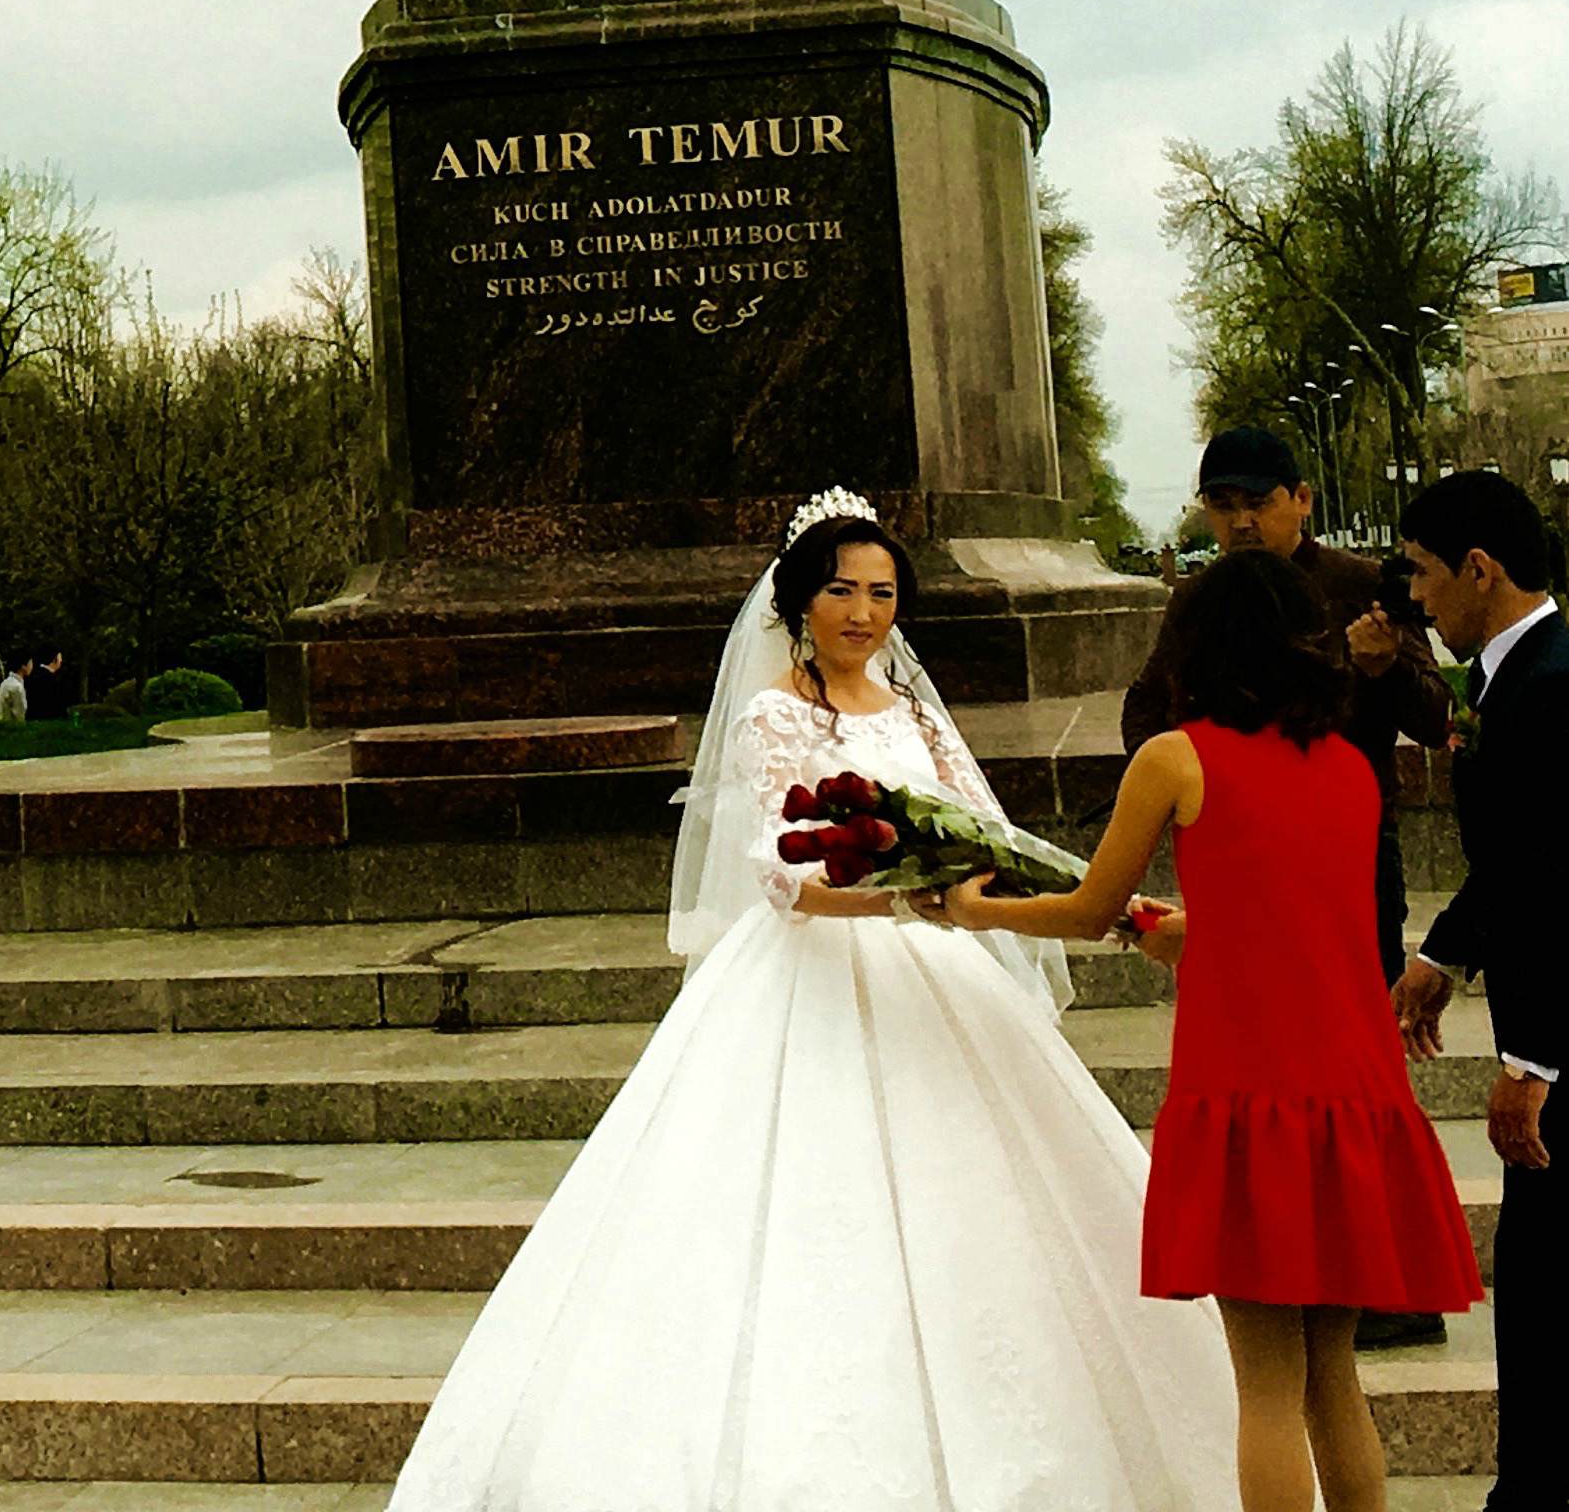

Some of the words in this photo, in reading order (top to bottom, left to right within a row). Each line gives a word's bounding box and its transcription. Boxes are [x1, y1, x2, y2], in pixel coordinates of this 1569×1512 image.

[431, 131, 597, 182] AMIR
[628, 115, 852, 167] TEMUR
[492, 203, 570, 226] KUCH
[587, 186, 793, 219] ADOLATDADUR
[450, 241, 529, 266] СИЛА
[549, 234, 566, 257] В
[576, 219, 844, 257] СПРАВЕДЛИВОСТИ
[486, 270, 629, 299] STRENGTH
[653, 267, 683, 288] IN
[692, 259, 810, 287] JUSTICE
